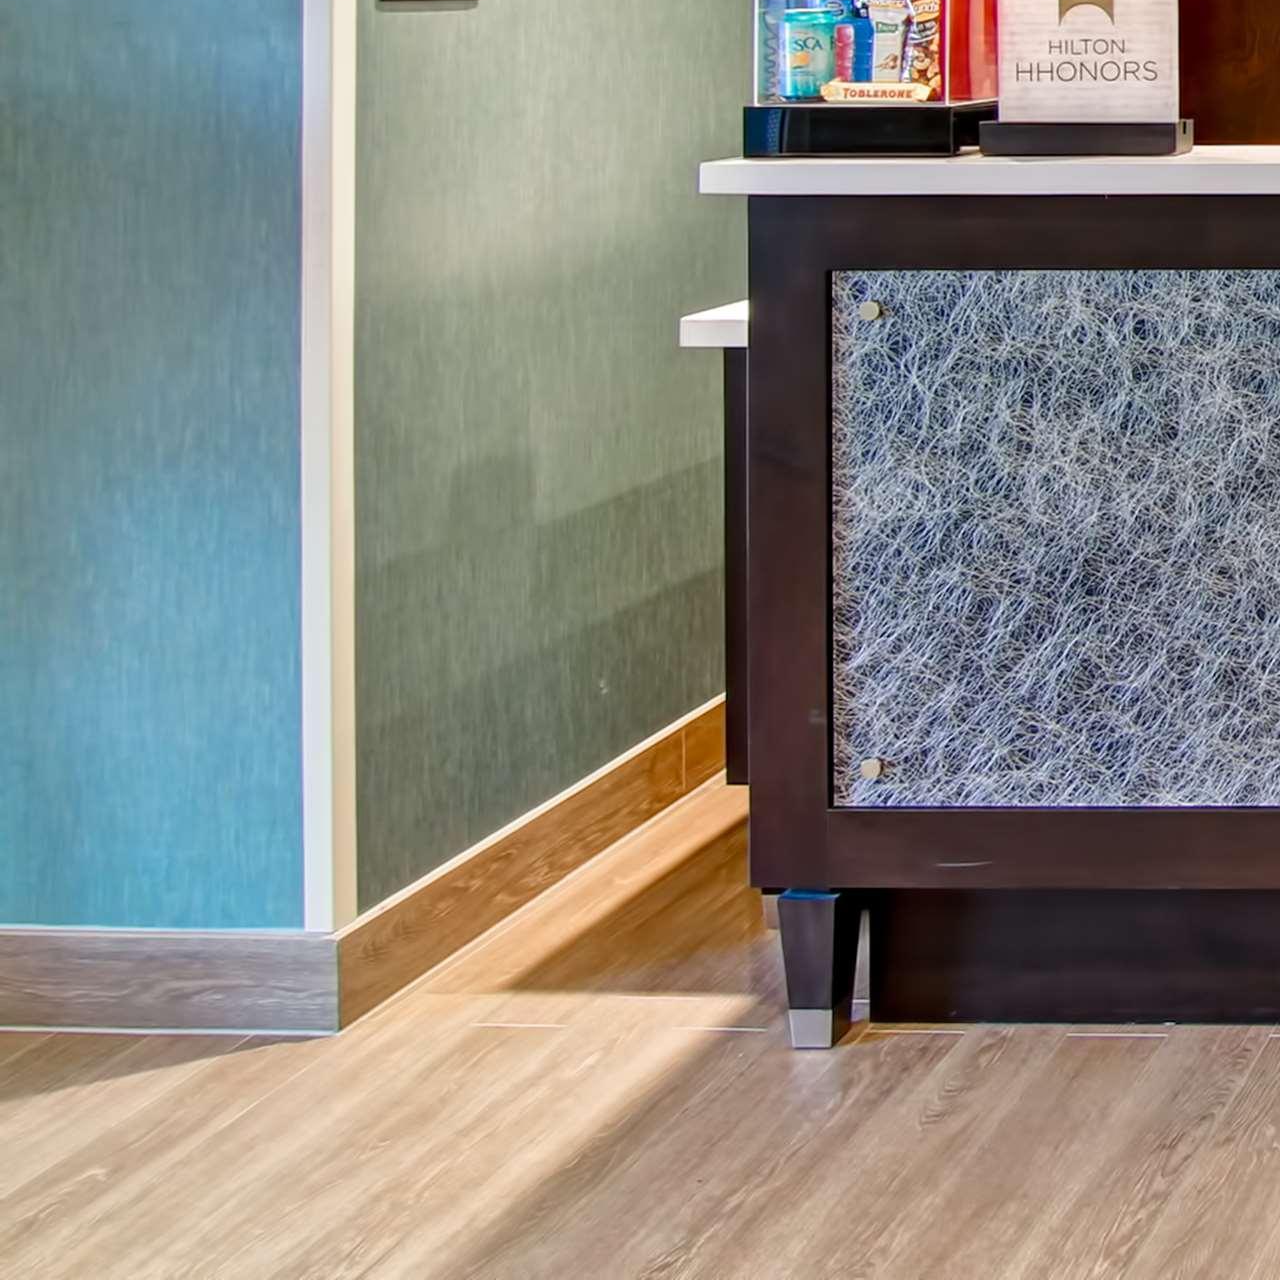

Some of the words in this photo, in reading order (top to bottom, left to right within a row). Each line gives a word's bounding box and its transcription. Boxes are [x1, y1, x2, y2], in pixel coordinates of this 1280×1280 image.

[1048, 38, 1126, 55] HILTON
[1015, 60, 1159, 82] HHONORS
[842, 87, 913, 99] TOBLERONE
